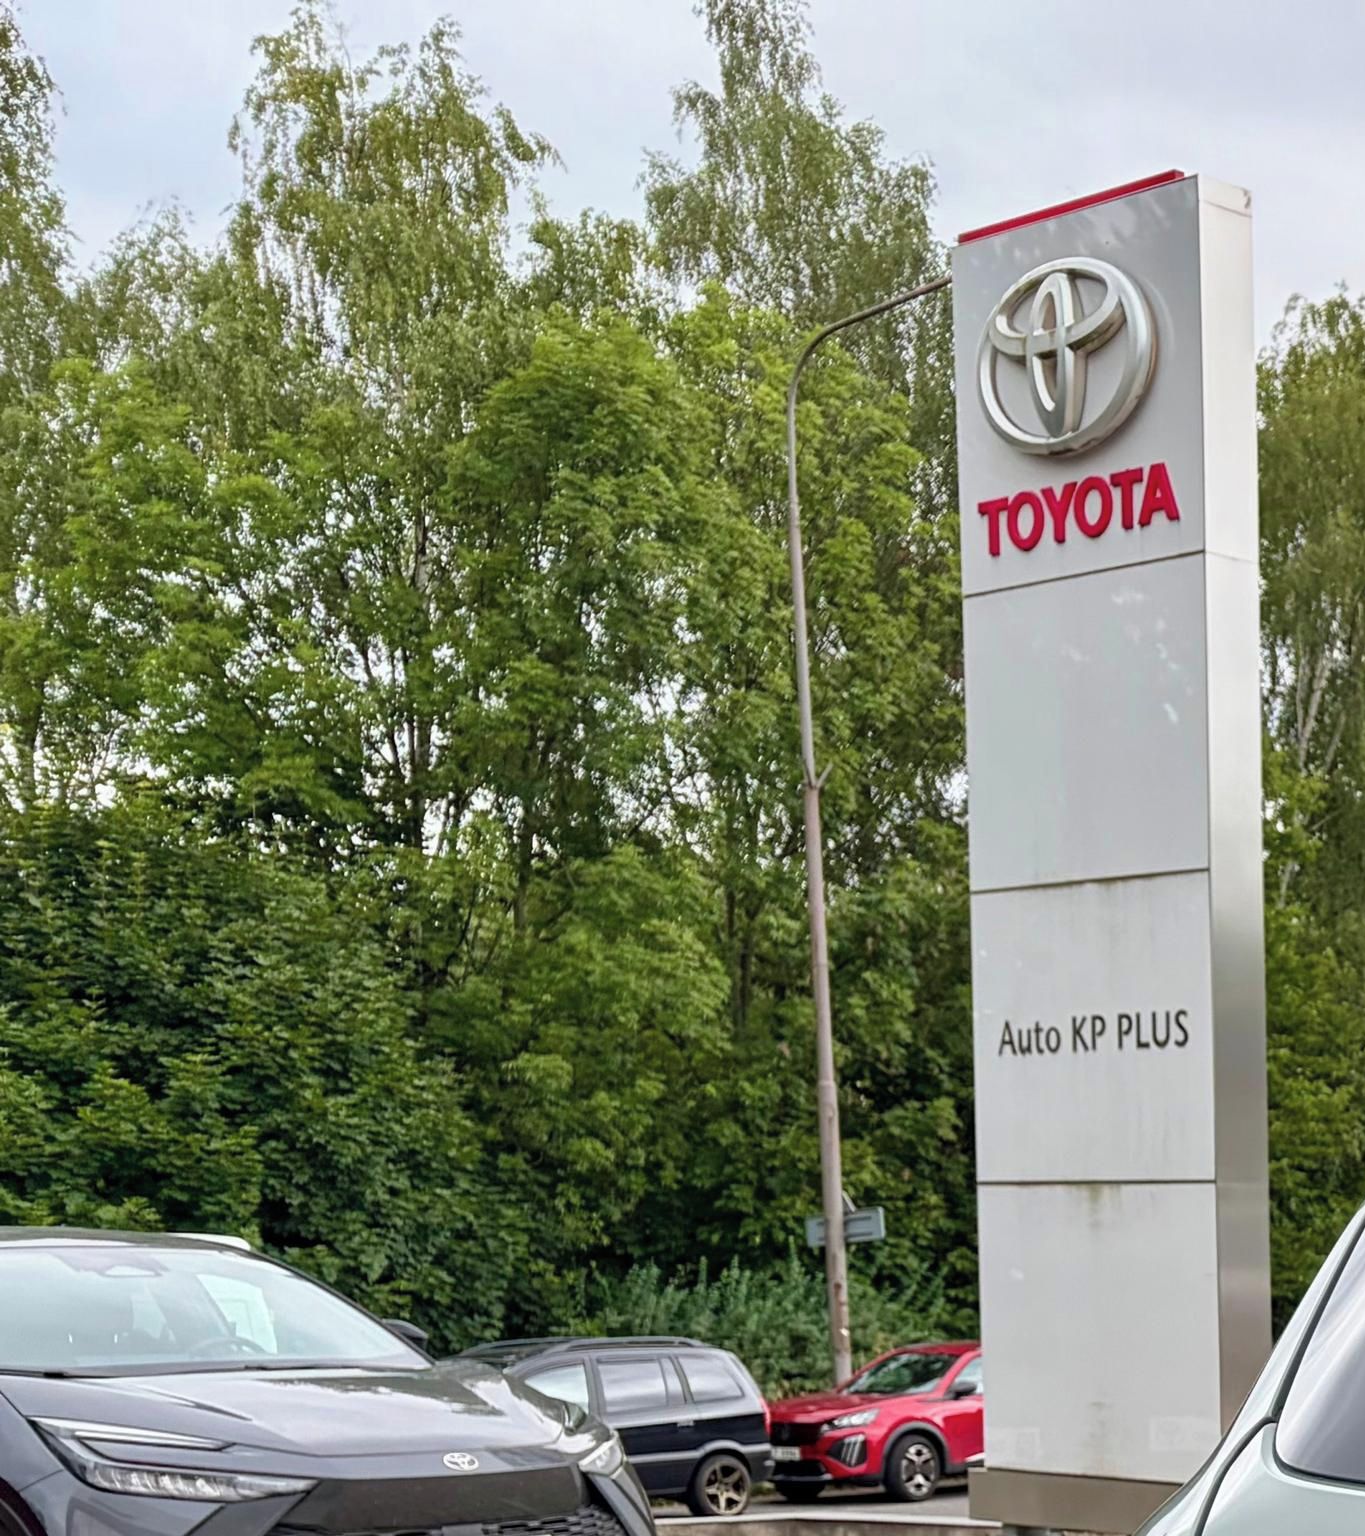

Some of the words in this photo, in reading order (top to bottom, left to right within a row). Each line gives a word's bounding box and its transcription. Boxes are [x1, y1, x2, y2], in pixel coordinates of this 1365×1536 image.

[978, 462, 1180, 557] TOYOTA
[998, 1020, 1061, 1056] Auto
[1072, 1014, 1106, 1053] KP
[1117, 1009, 1189, 1049] PLUS
